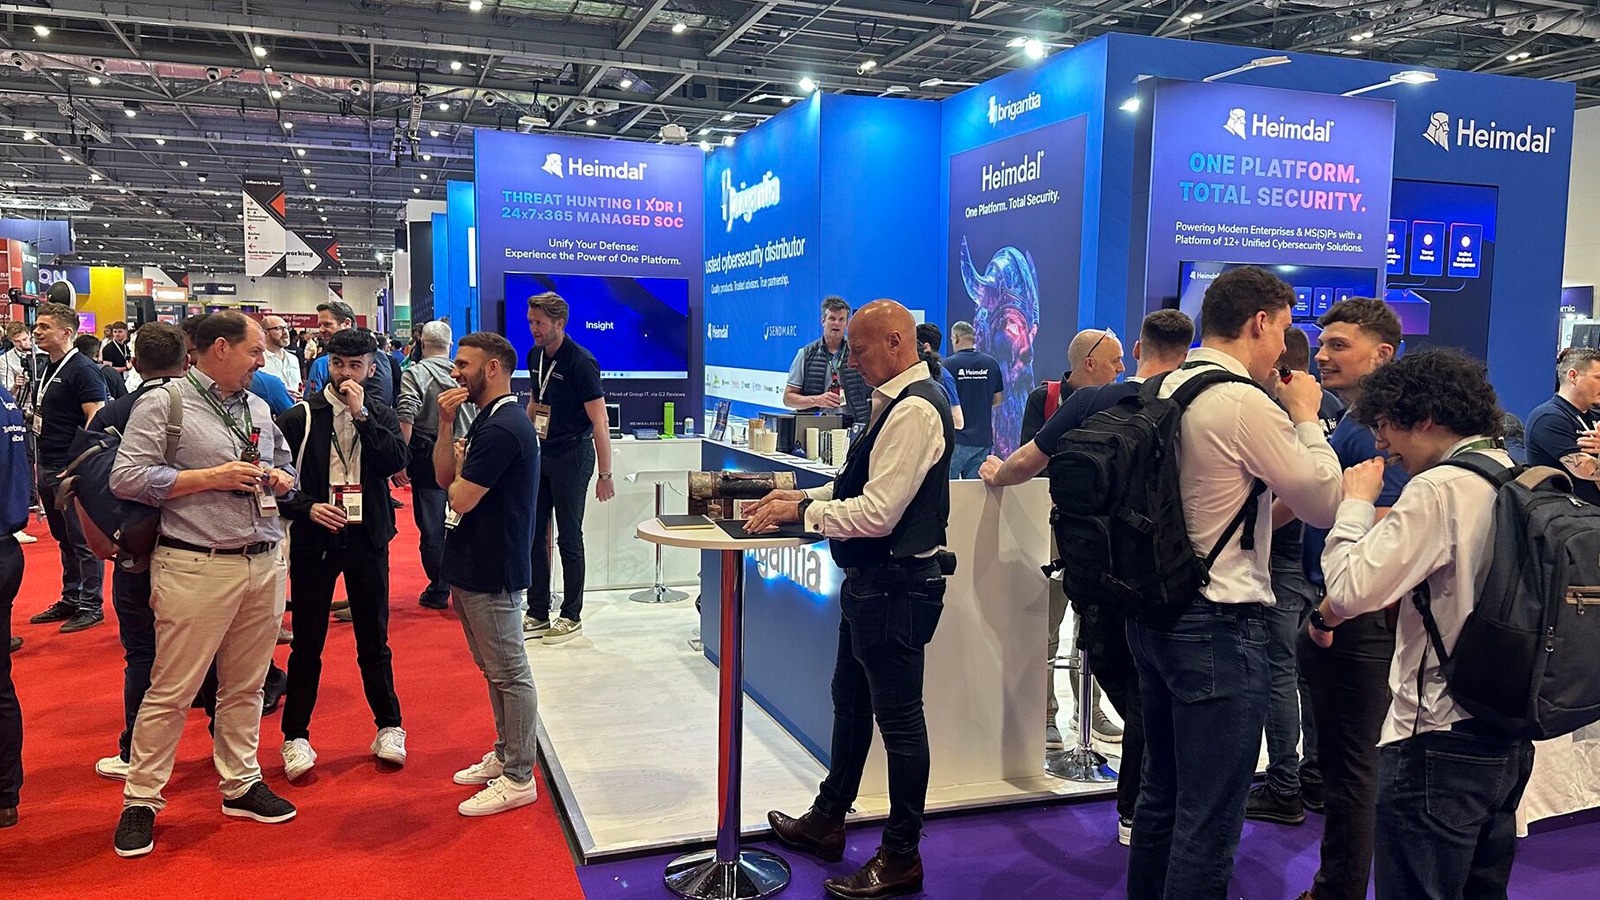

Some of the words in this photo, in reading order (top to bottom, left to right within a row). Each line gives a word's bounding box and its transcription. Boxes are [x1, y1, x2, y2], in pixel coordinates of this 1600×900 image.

[998, 92, 1041, 120] brigantia
[1252, 113, 1331, 142] Heimdal
[1457, 118, 1551, 154] Heimdal
[568, 158, 644, 180] Heimdal
[982, 150, 1042, 191] Heimdal
[1189, 152, 1236, 174] ONE
[1241, 156, 1361, 184] PLATFORM.
[502, 190, 562, 206] THREAT
[566, 194, 632, 210] HUNTING
[645, 197, 674, 212] XDR
[730, 170, 780, 222] brigantia
[965, 206, 978, 218] One
[978, 201, 1008, 216] Platform.
[1008, 195, 1026, 210] Total
[1026, 189, 1060, 206] Security.
[1179, 182, 1251, 204] TOTAL
[1257, 187, 1367, 212] SECURITY.
[502, 207, 573, 222] 24x7x365
[576, 212, 650, 226] MANAGED
[654, 216, 684, 228] SOC
[1176, 221, 1216, 236] Powering
[1218, 224, 1248, 234] Modern
[1250, 225, 1295, 238] Enterprises
[1296, 228, 1302, 237] &
[1304, 228, 1337, 240] MS(S)Ps
[1338, 230, 1356, 240] with
[548, 238, 574, 250] Unify
[576, 240, 597, 250] Your
[599, 240, 639, 251] Defense:
[1175, 235, 1211, 246] Platform
[1212, 236, 1222, 246] of
[1224, 236, 1240, 246] 12+
[1242, 238, 1270, 248] Unified
[1272, 239, 1324, 252] Cybersecurity
[1326, 242, 1364, 252] Solutions.
[505, 248, 557, 260] Experience
[559, 251, 574, 260] the
[576, 252, 606, 262] Power
[608, 253, 618, 263] of
[620, 254, 639, 264] One
[641, 255, 682, 265] Platform.
[721, 244, 764, 274] cybersecurity
[764, 236, 806, 262] distributor
[586, 320, 614, 331] Insight
[712, 324, 729, 338] Heimdal
[769, 325, 797, 337] SENDMARC
